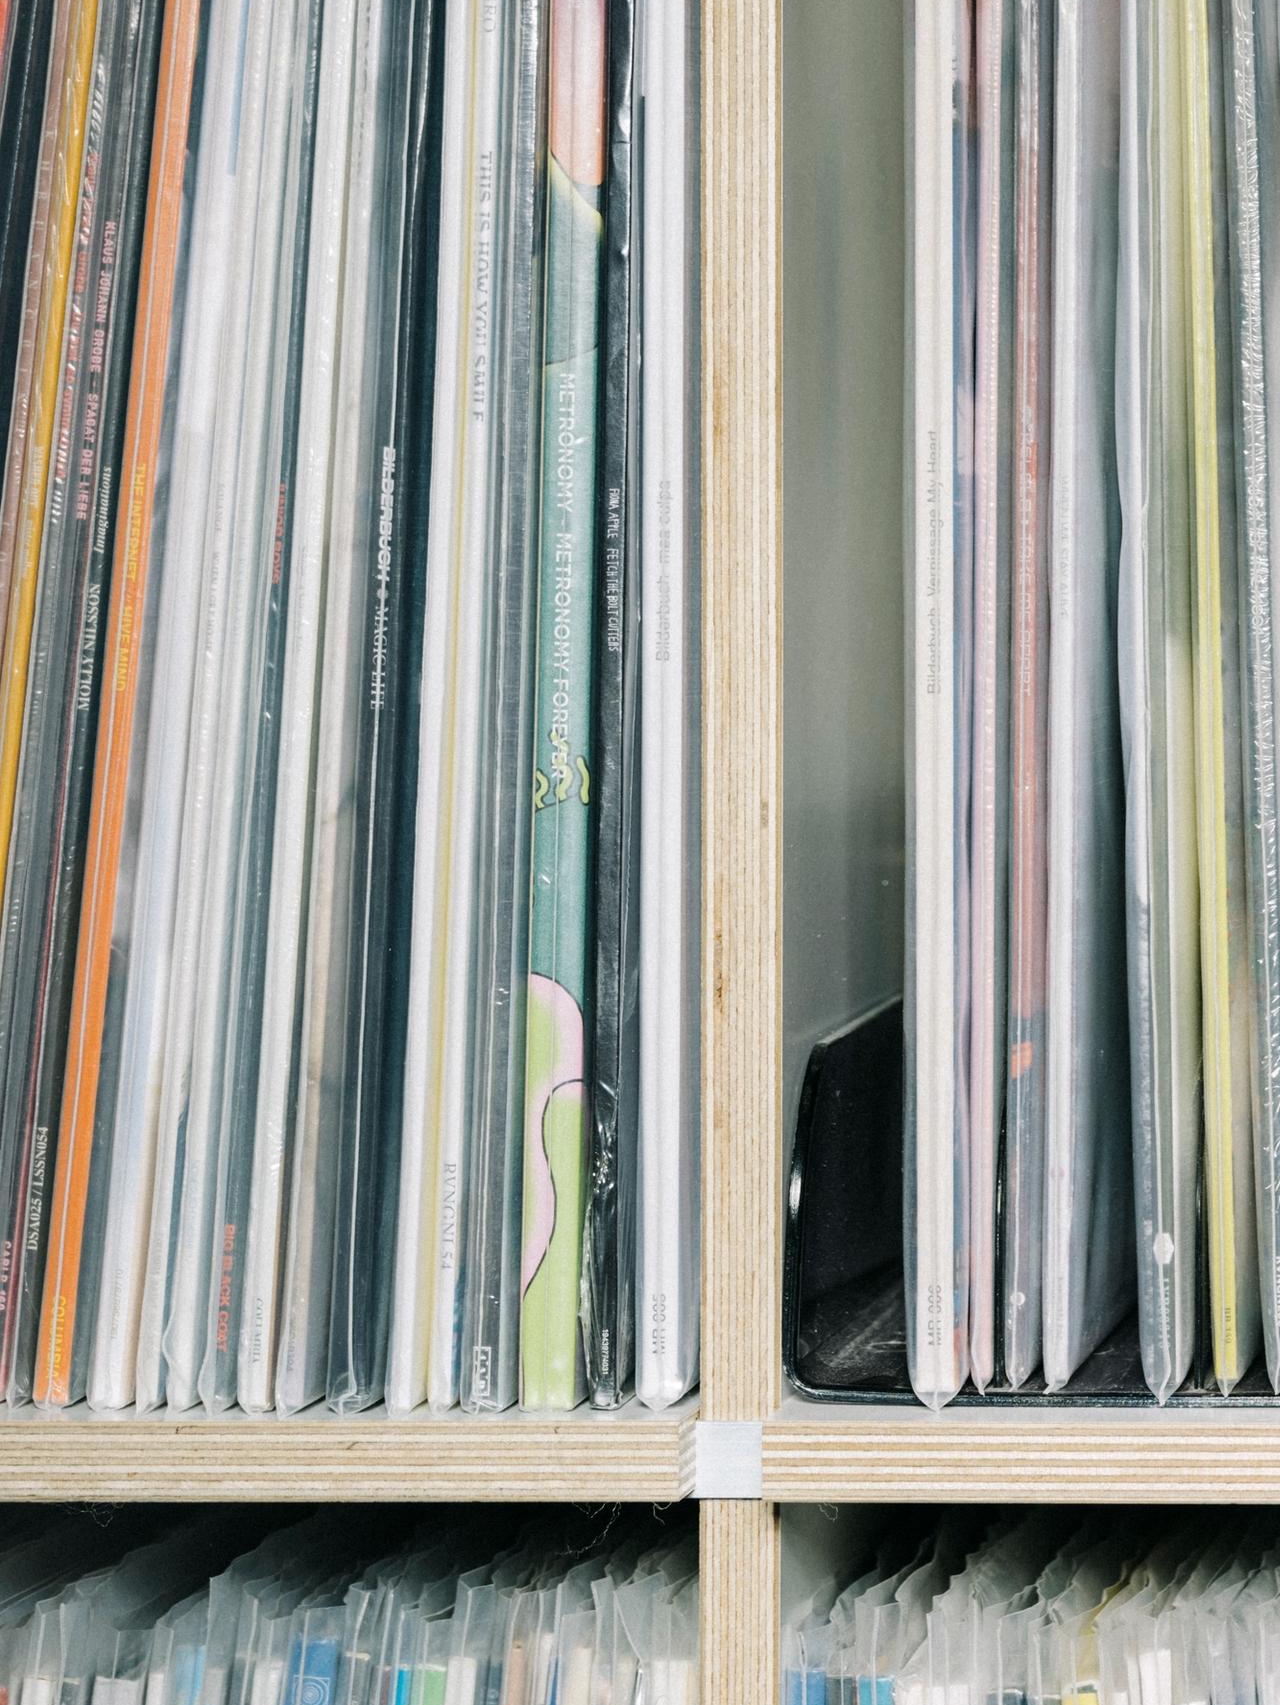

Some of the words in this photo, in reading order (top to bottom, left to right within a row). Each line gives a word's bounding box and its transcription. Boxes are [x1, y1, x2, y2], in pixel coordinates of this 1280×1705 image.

[101, 221, 118, 264] KLAUS
[94, 270, 114, 323] JOHANN
[89, 329, 105, 373] GROBE
[82, 393, 98, 445] SPAGAT
[79, 450, 93, 475] DER
[557, 374, 575, 513] METRONOMY
[132, 463, 148, 494] THE
[608, 488, 619, 509] FIONA
[77, 481, 90, 520] LIEBE
[94, 467, 114, 553] Imaginations
[377, 446, 395, 581] BILDERBUCH
[125, 499, 143, 581] INTERNET
[607, 511, 619, 539] APPLE
[606, 548, 619, 576] FETCH
[553, 532, 573, 670] METRONOMY
[606, 578, 618, 593] THE
[606, 596, 618, 615] BOLT
[83, 583, 101, 653] NILSSON
[119, 605, 132, 644] HIVE
[373, 605, 388, 665] MAGIC
[607, 618, 619, 651] CUTTERS
[77, 656, 93, 711] MOLLY
[116, 650, 130, 692] MIND
[371, 671, 386, 711] LIFE
[551, 679, 569, 778] FOREVER
